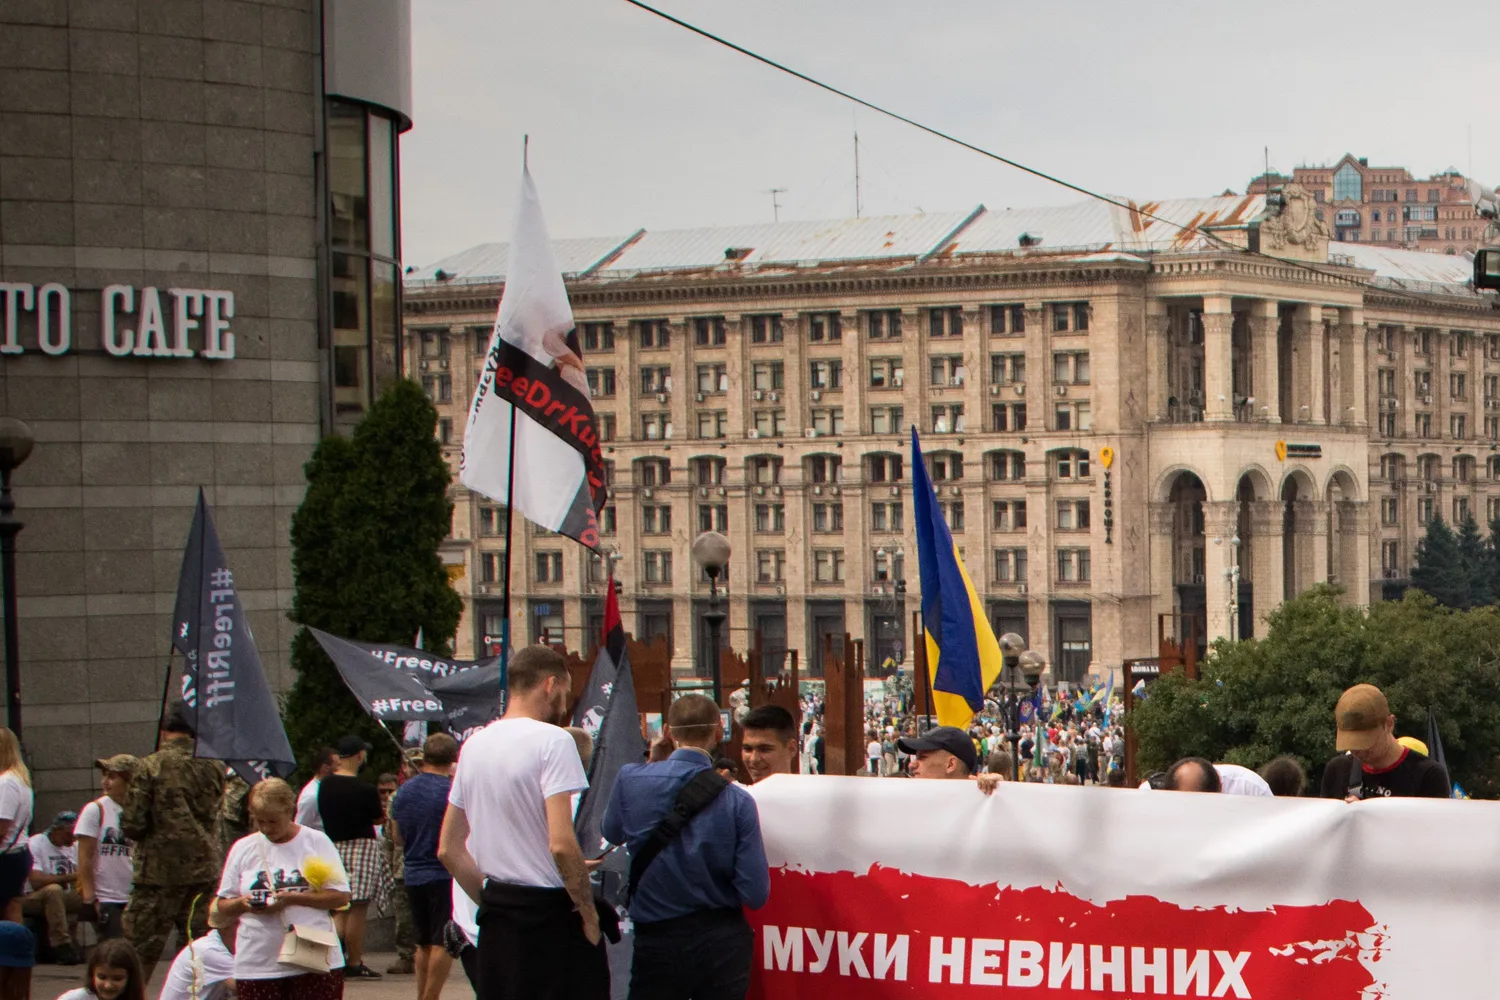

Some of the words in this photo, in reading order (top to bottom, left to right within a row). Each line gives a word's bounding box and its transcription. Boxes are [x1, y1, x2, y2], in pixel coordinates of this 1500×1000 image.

[102, 284, 236, 360] CAFE
[763, 925, 910, 982] МУКИ
[928, 936, 1253, 1000] НЕВИННИХ
